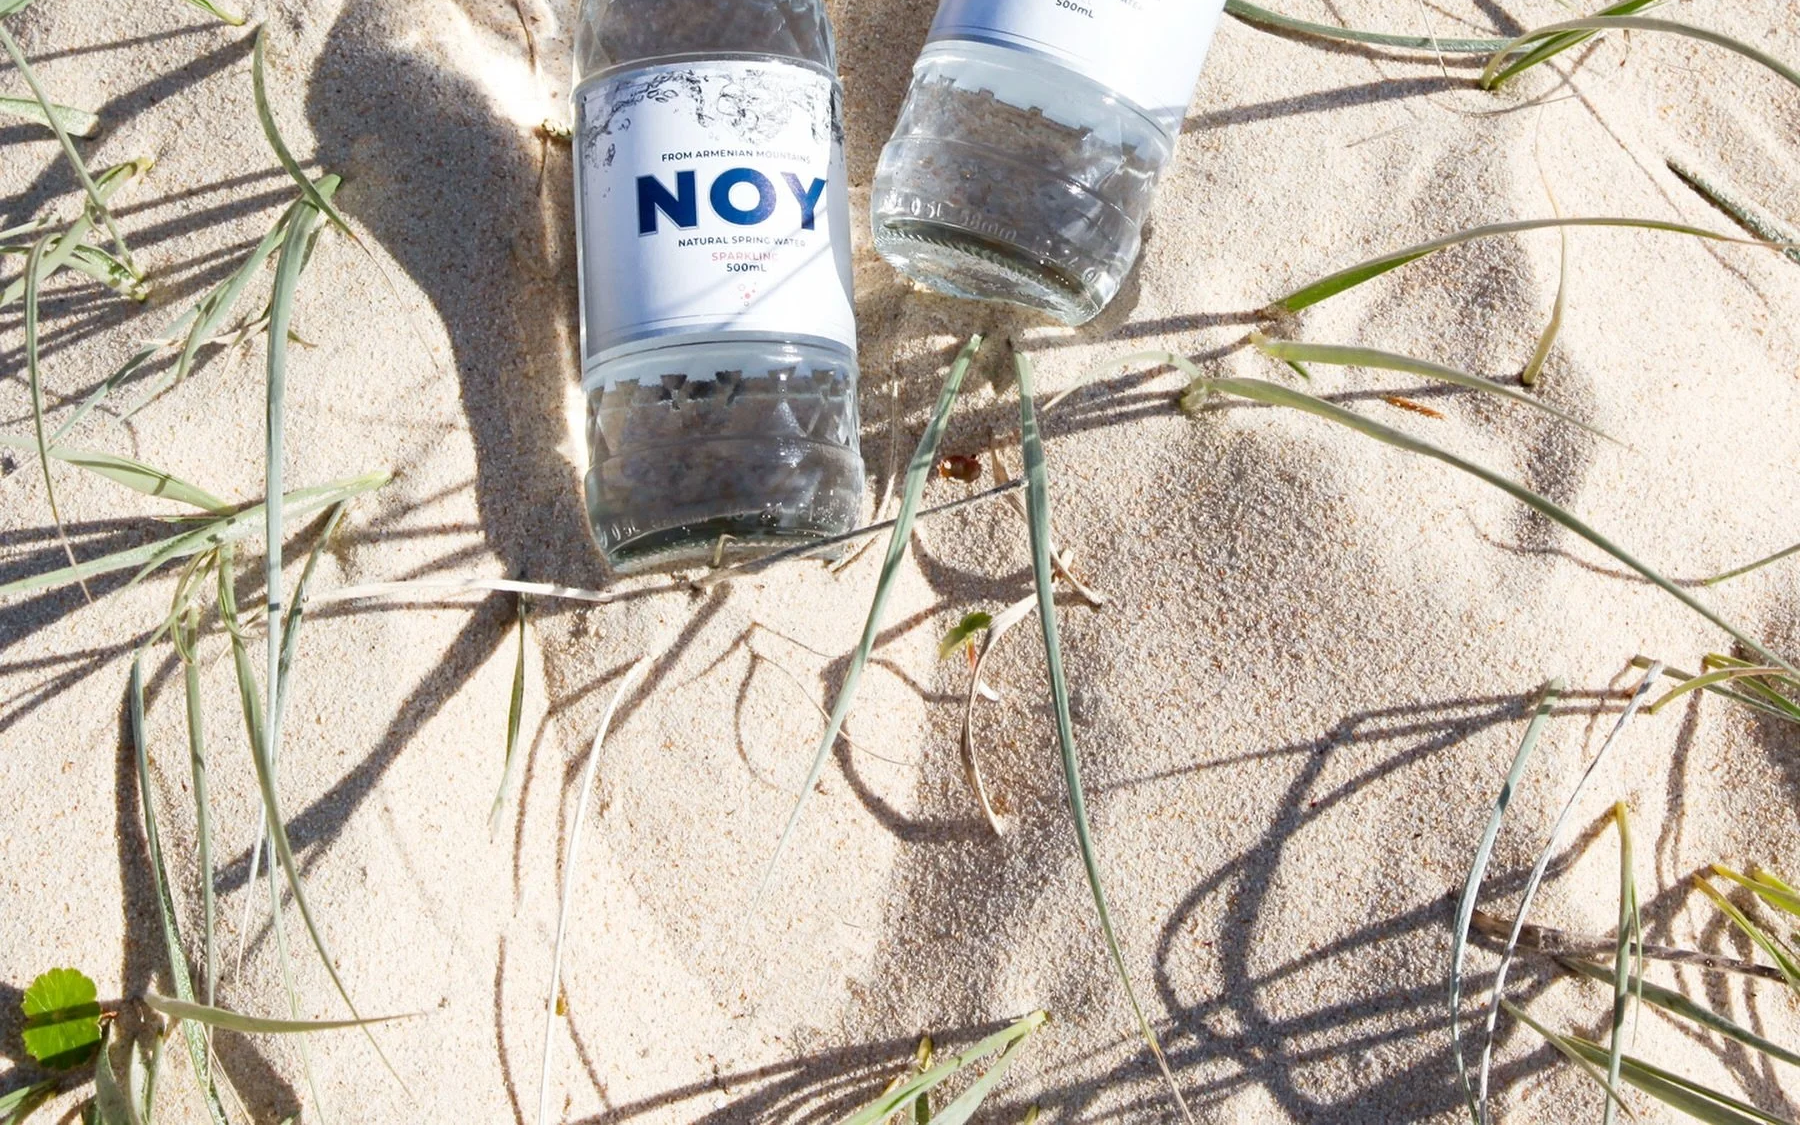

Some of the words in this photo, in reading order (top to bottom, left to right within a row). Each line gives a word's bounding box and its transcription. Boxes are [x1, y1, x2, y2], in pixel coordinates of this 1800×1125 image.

[661, 151, 693, 163] FROM
[695, 149, 754, 159] ARMENIAN
[755, 150, 811, 164] MOUNTAINS
[636, 167, 827, 237] NOY
[677, 236, 729, 248] NATURAL
[731, 235, 771, 245] SPRING
[773, 237, 806, 248] WATER
[725, 262, 768, 273] 500mL
